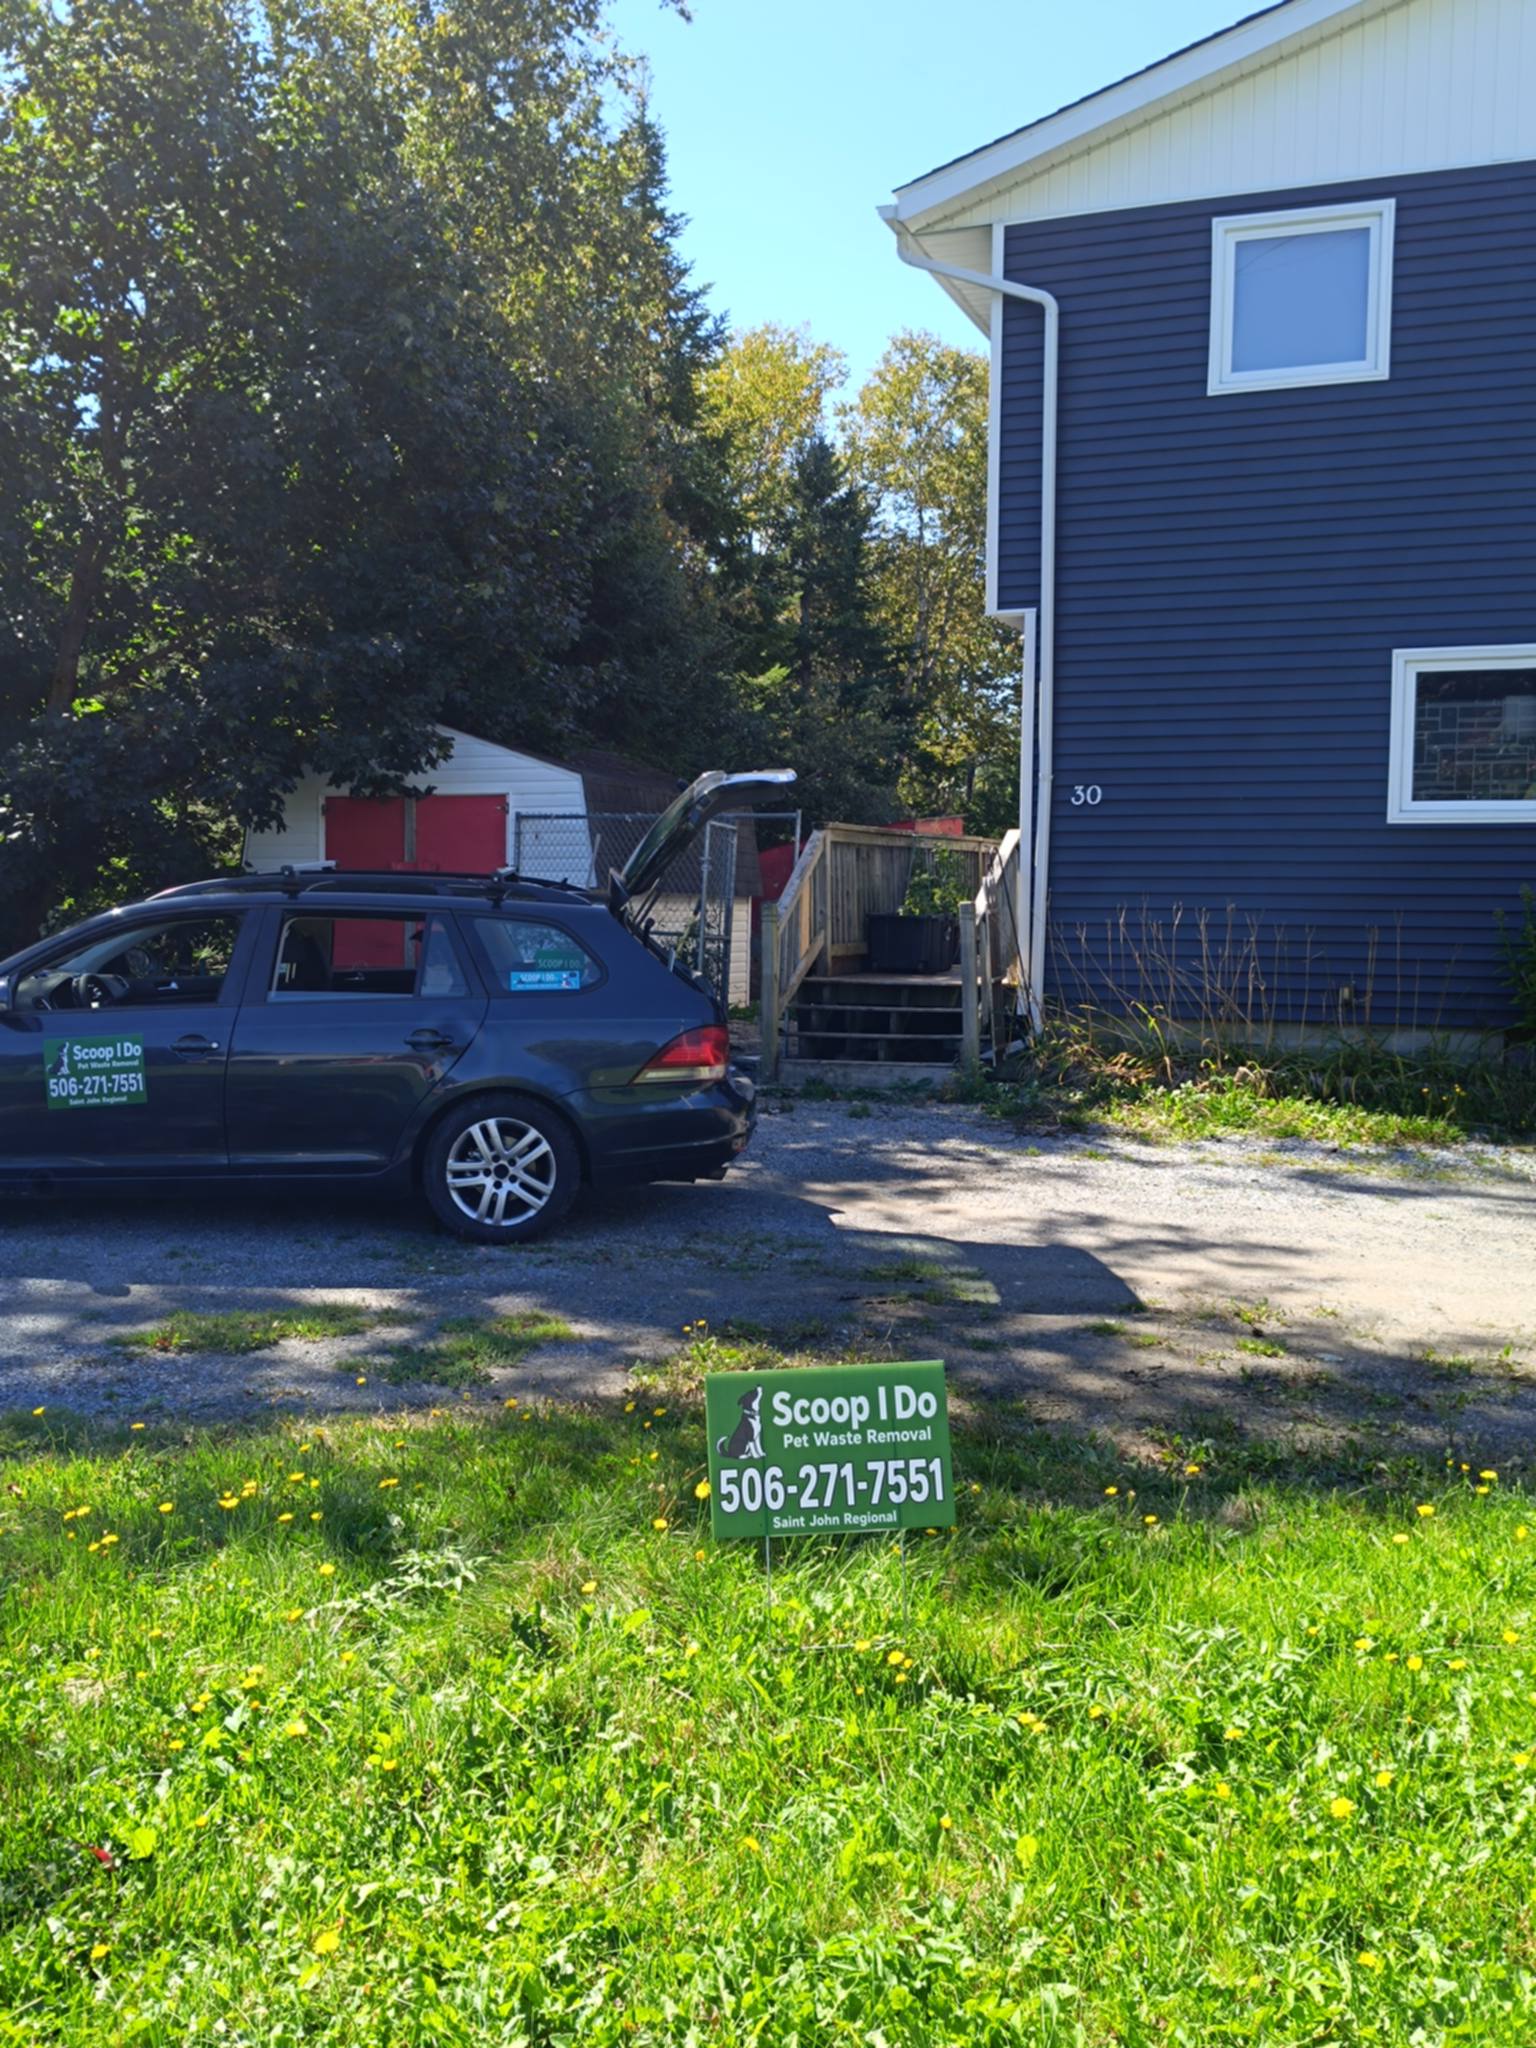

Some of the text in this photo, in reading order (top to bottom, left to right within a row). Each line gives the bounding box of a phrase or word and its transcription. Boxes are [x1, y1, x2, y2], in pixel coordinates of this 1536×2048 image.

[1071, 785, 1102, 805] 30
[73, 1042, 142, 1061] Scoop I Do
[49, 1072, 144, 1098] 506-271-7551
[772, 1384, 938, 1430] Scoop I Do
[783, 1426, 932, 1449] Pet Waste Removal
[719, 1457, 944, 1513] 506-271-7551
[773, 1510, 897, 1529] Saint John Regional
